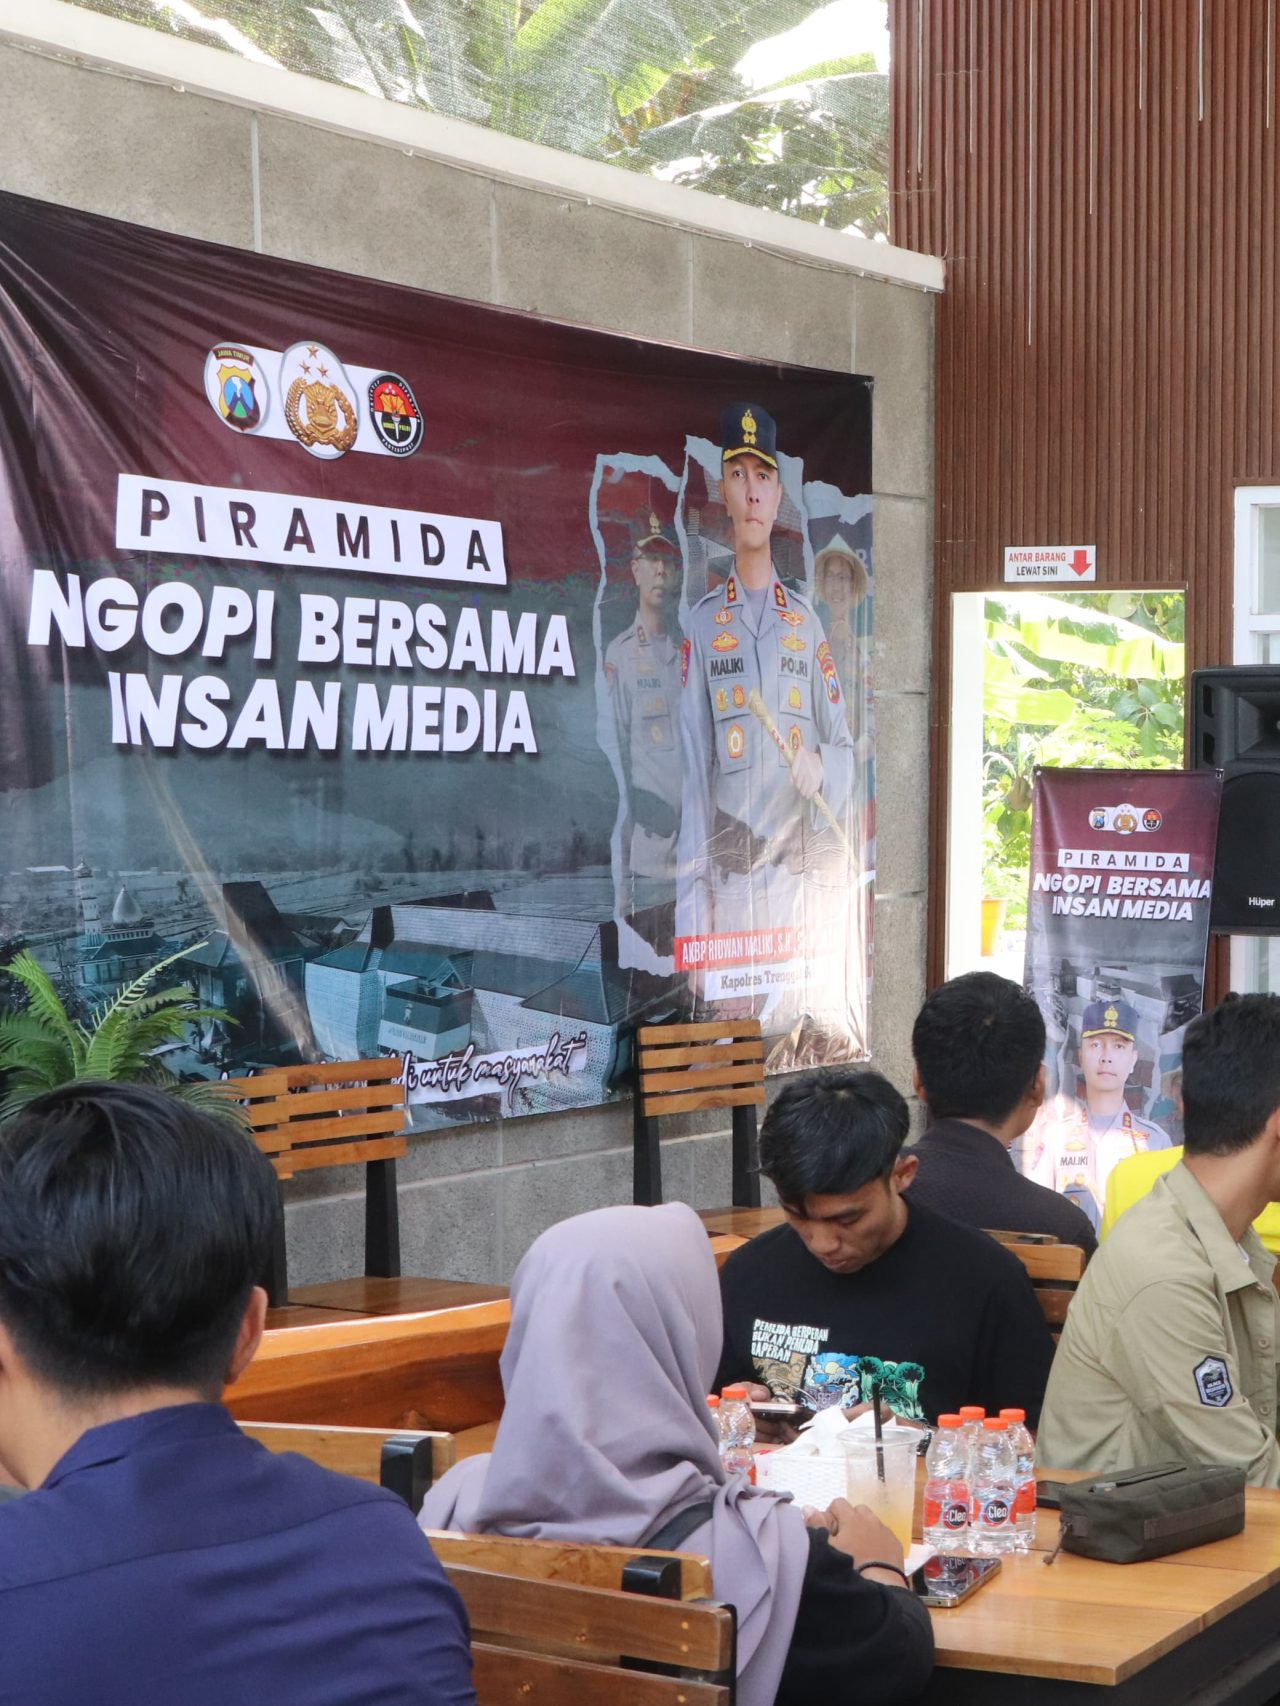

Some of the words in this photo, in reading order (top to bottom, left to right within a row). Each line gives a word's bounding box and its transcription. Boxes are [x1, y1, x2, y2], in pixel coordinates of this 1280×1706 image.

[140, 489, 491, 572] PIRAMIDA
[1008, 552, 1033, 562] ANTAR
[1035, 552, 1066, 562] BARANG
[1016, 566, 1040, 576] LEWAT
[1042, 566, 1058, 576] SINI
[27, 569, 275, 659] NGOPI
[297, 593, 576, 676] BERSAMA
[711, 657, 744, 677] MALIKI
[108, 671, 341, 750] INSAN
[352, 683, 538, 753] MEDIA
[1064, 852, 1182, 869] PIRAMIDA
[1033, 873, 1101, 894] NGOPI
[1106, 875, 1211, 899] BERSAMA
[1052, 896, 1120, 918] INSAN
[1121, 899, 1193, 921] MEDIA
[682, 941, 706, 964] AKBP
[708, 937, 743, 961] RIDWAN
[721, 972, 762, 992] Kapolres
[421, 1043, 475, 1092] untuk
[1060, 1156, 1088, 1166] MALIKI
[754, 1319, 791, 1337] PEMUDA
[791, 1325, 829, 1341] BERPERAN
[751, 1342, 791, 1362] BAPERAN
[752, 1331, 785, 1347] BUKAN
[784, 1336, 819, 1354] PEMUDA
[948, 1510, 966, 1522] Cleo
[988, 1505, 1007, 1519] Cleo
